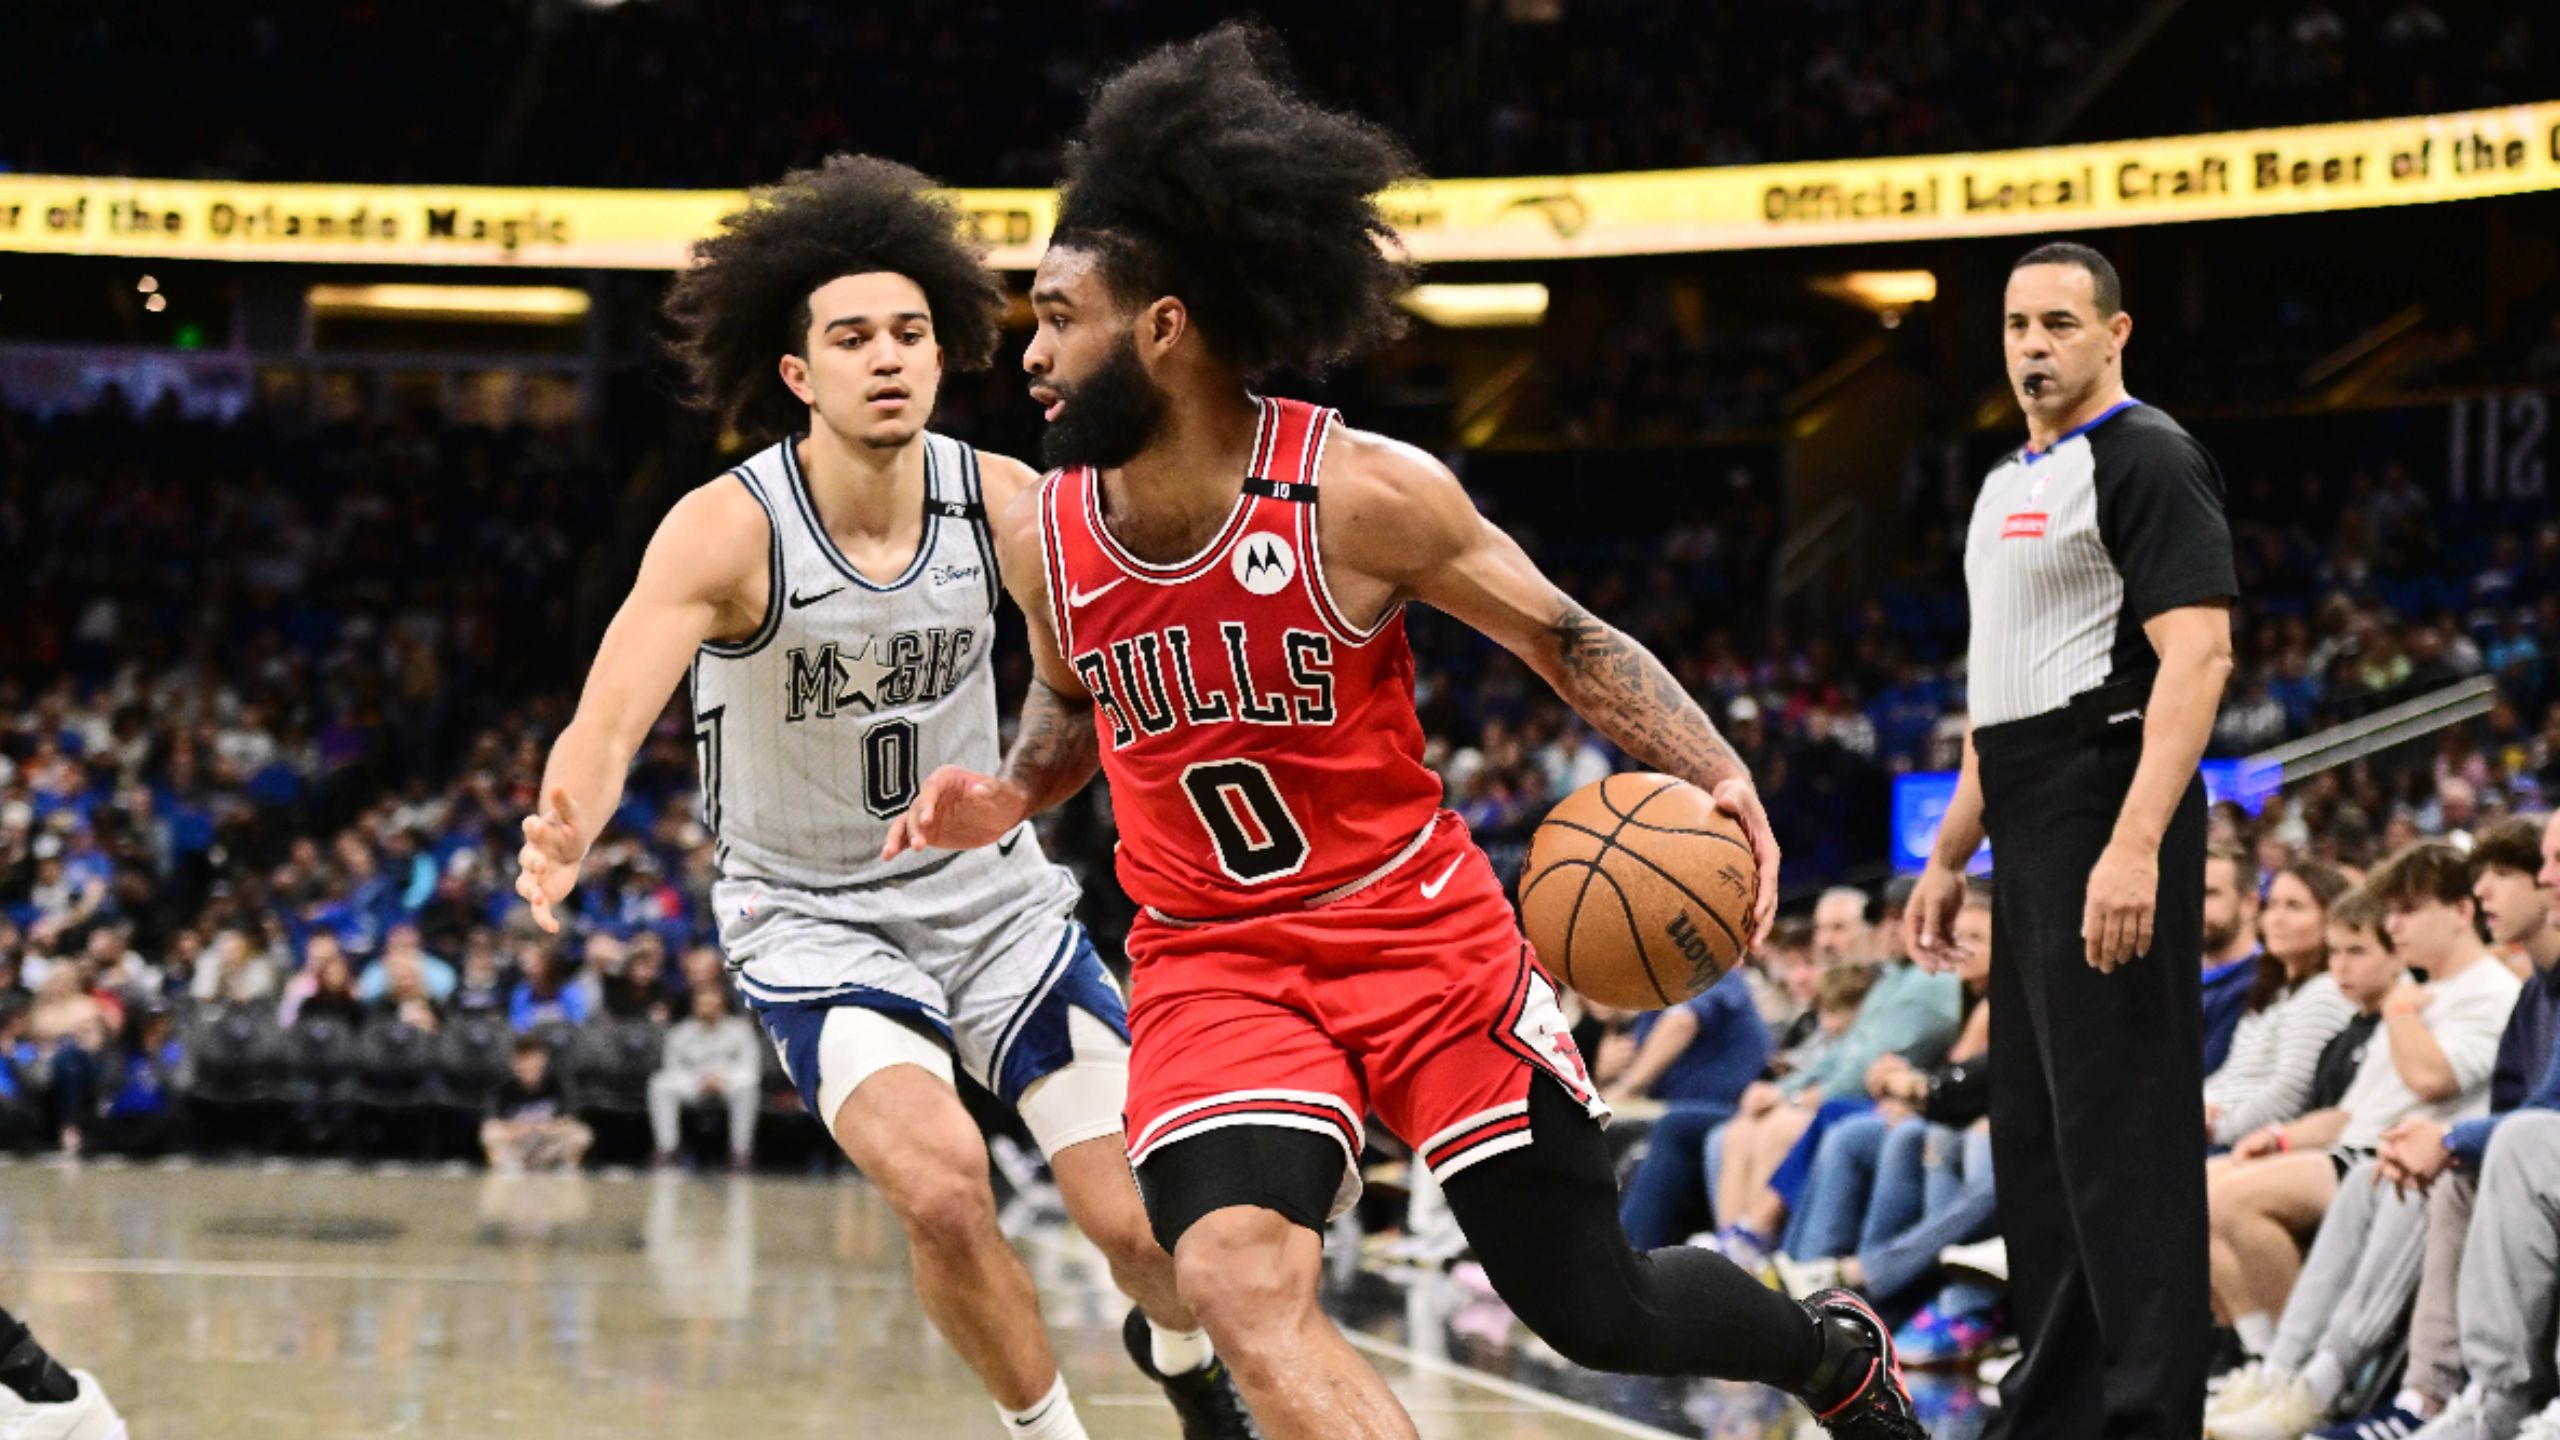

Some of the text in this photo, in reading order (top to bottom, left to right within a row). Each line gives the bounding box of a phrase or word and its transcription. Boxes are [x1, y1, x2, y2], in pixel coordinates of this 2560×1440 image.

[48, 197, 87, 230] of
[110, 200, 181, 232] the
[211, 203, 396, 237] Orlando
[427, 207, 568, 250] Magic
[1765, 177, 1938, 221] Official
[1965, 166, 2092, 211] Local
[2118, 157, 2227, 199] Craft
[2255, 152, 2364, 189] Beer
[2391, 139, 2430, 178] of
[2455, 133, 2524, 173] the
[1072, 621, 1337, 753] BULLS
[861, 716, 918, 820] 0
[1180, 757, 1311, 886] 0
